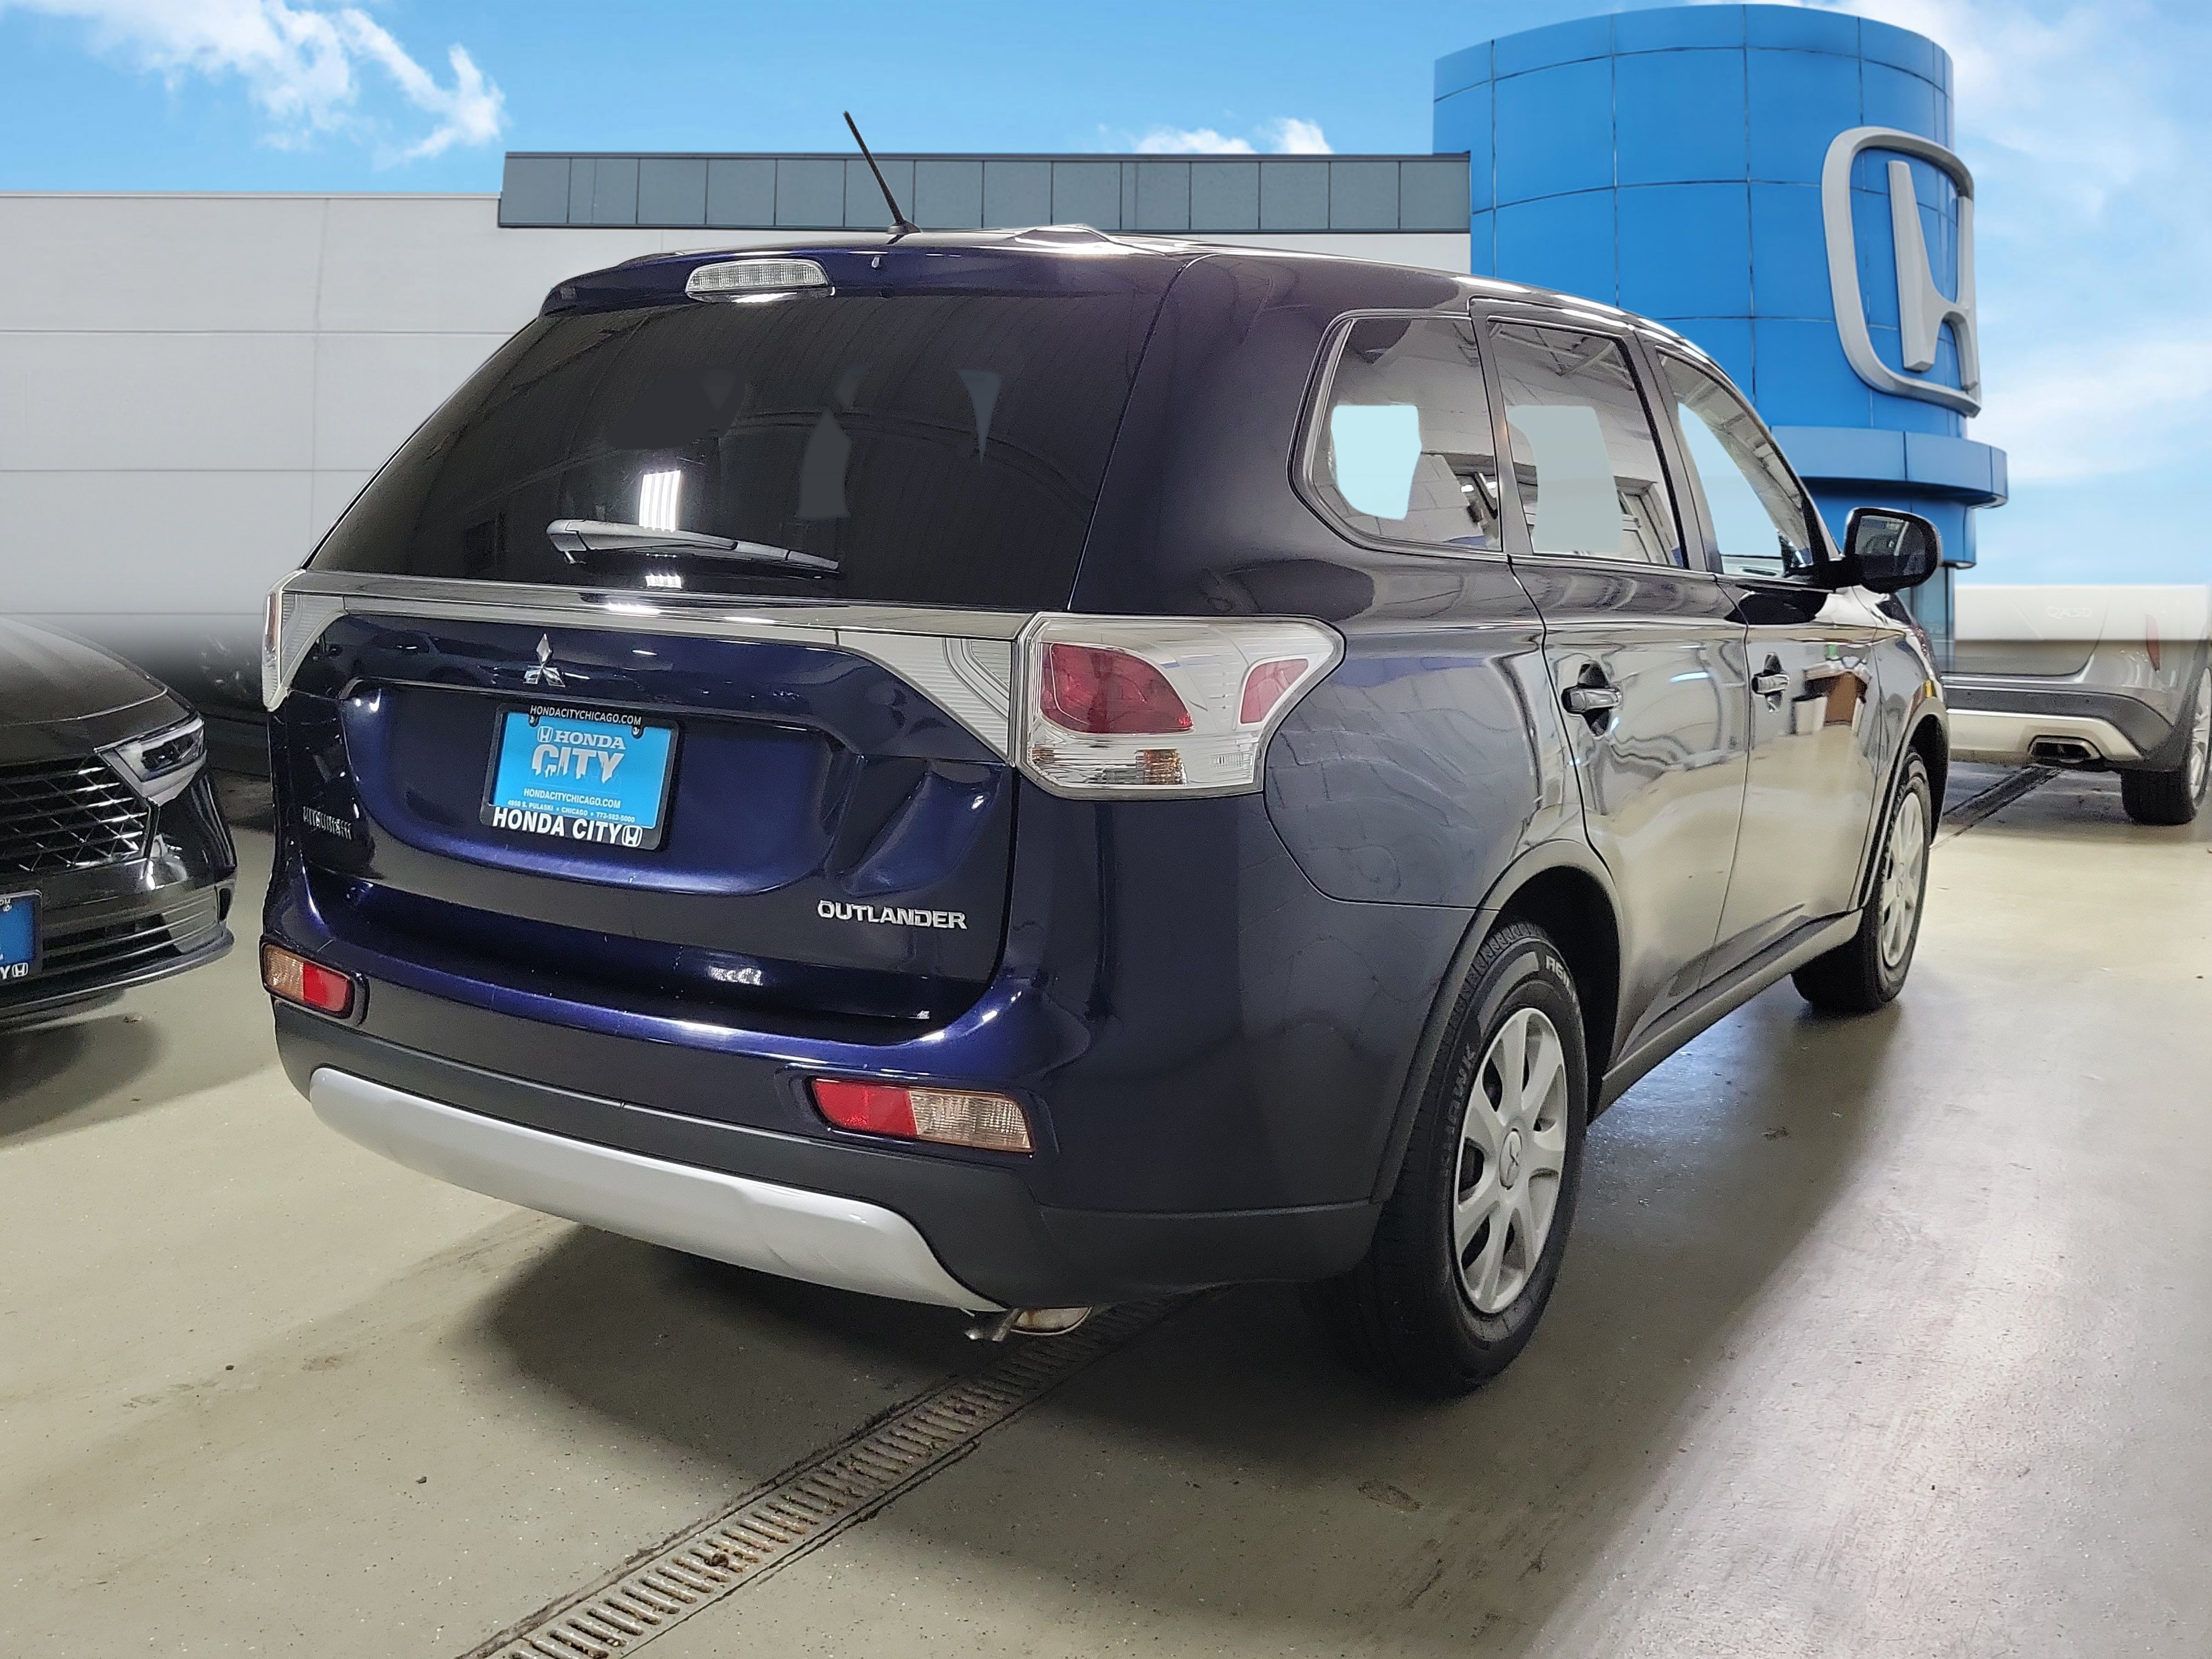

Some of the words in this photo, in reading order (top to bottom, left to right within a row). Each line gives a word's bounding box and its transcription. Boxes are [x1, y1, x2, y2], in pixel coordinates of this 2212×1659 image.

[530, 705, 642, 725] HONDACITYCHICAGO.COM
[554, 731, 626, 749] HONDA
[532, 744, 625, 783] CITY
[523, 788, 621, 808] HONDACITYCHICAGO.COM
[528, 803, 554, 811] PULASKI
[561, 807, 588, 816] CHICAGO
[493, 806, 565, 837] HONDA
[573, 817, 623, 844] CITY
[817, 900, 967, 929] OUTLANDER
